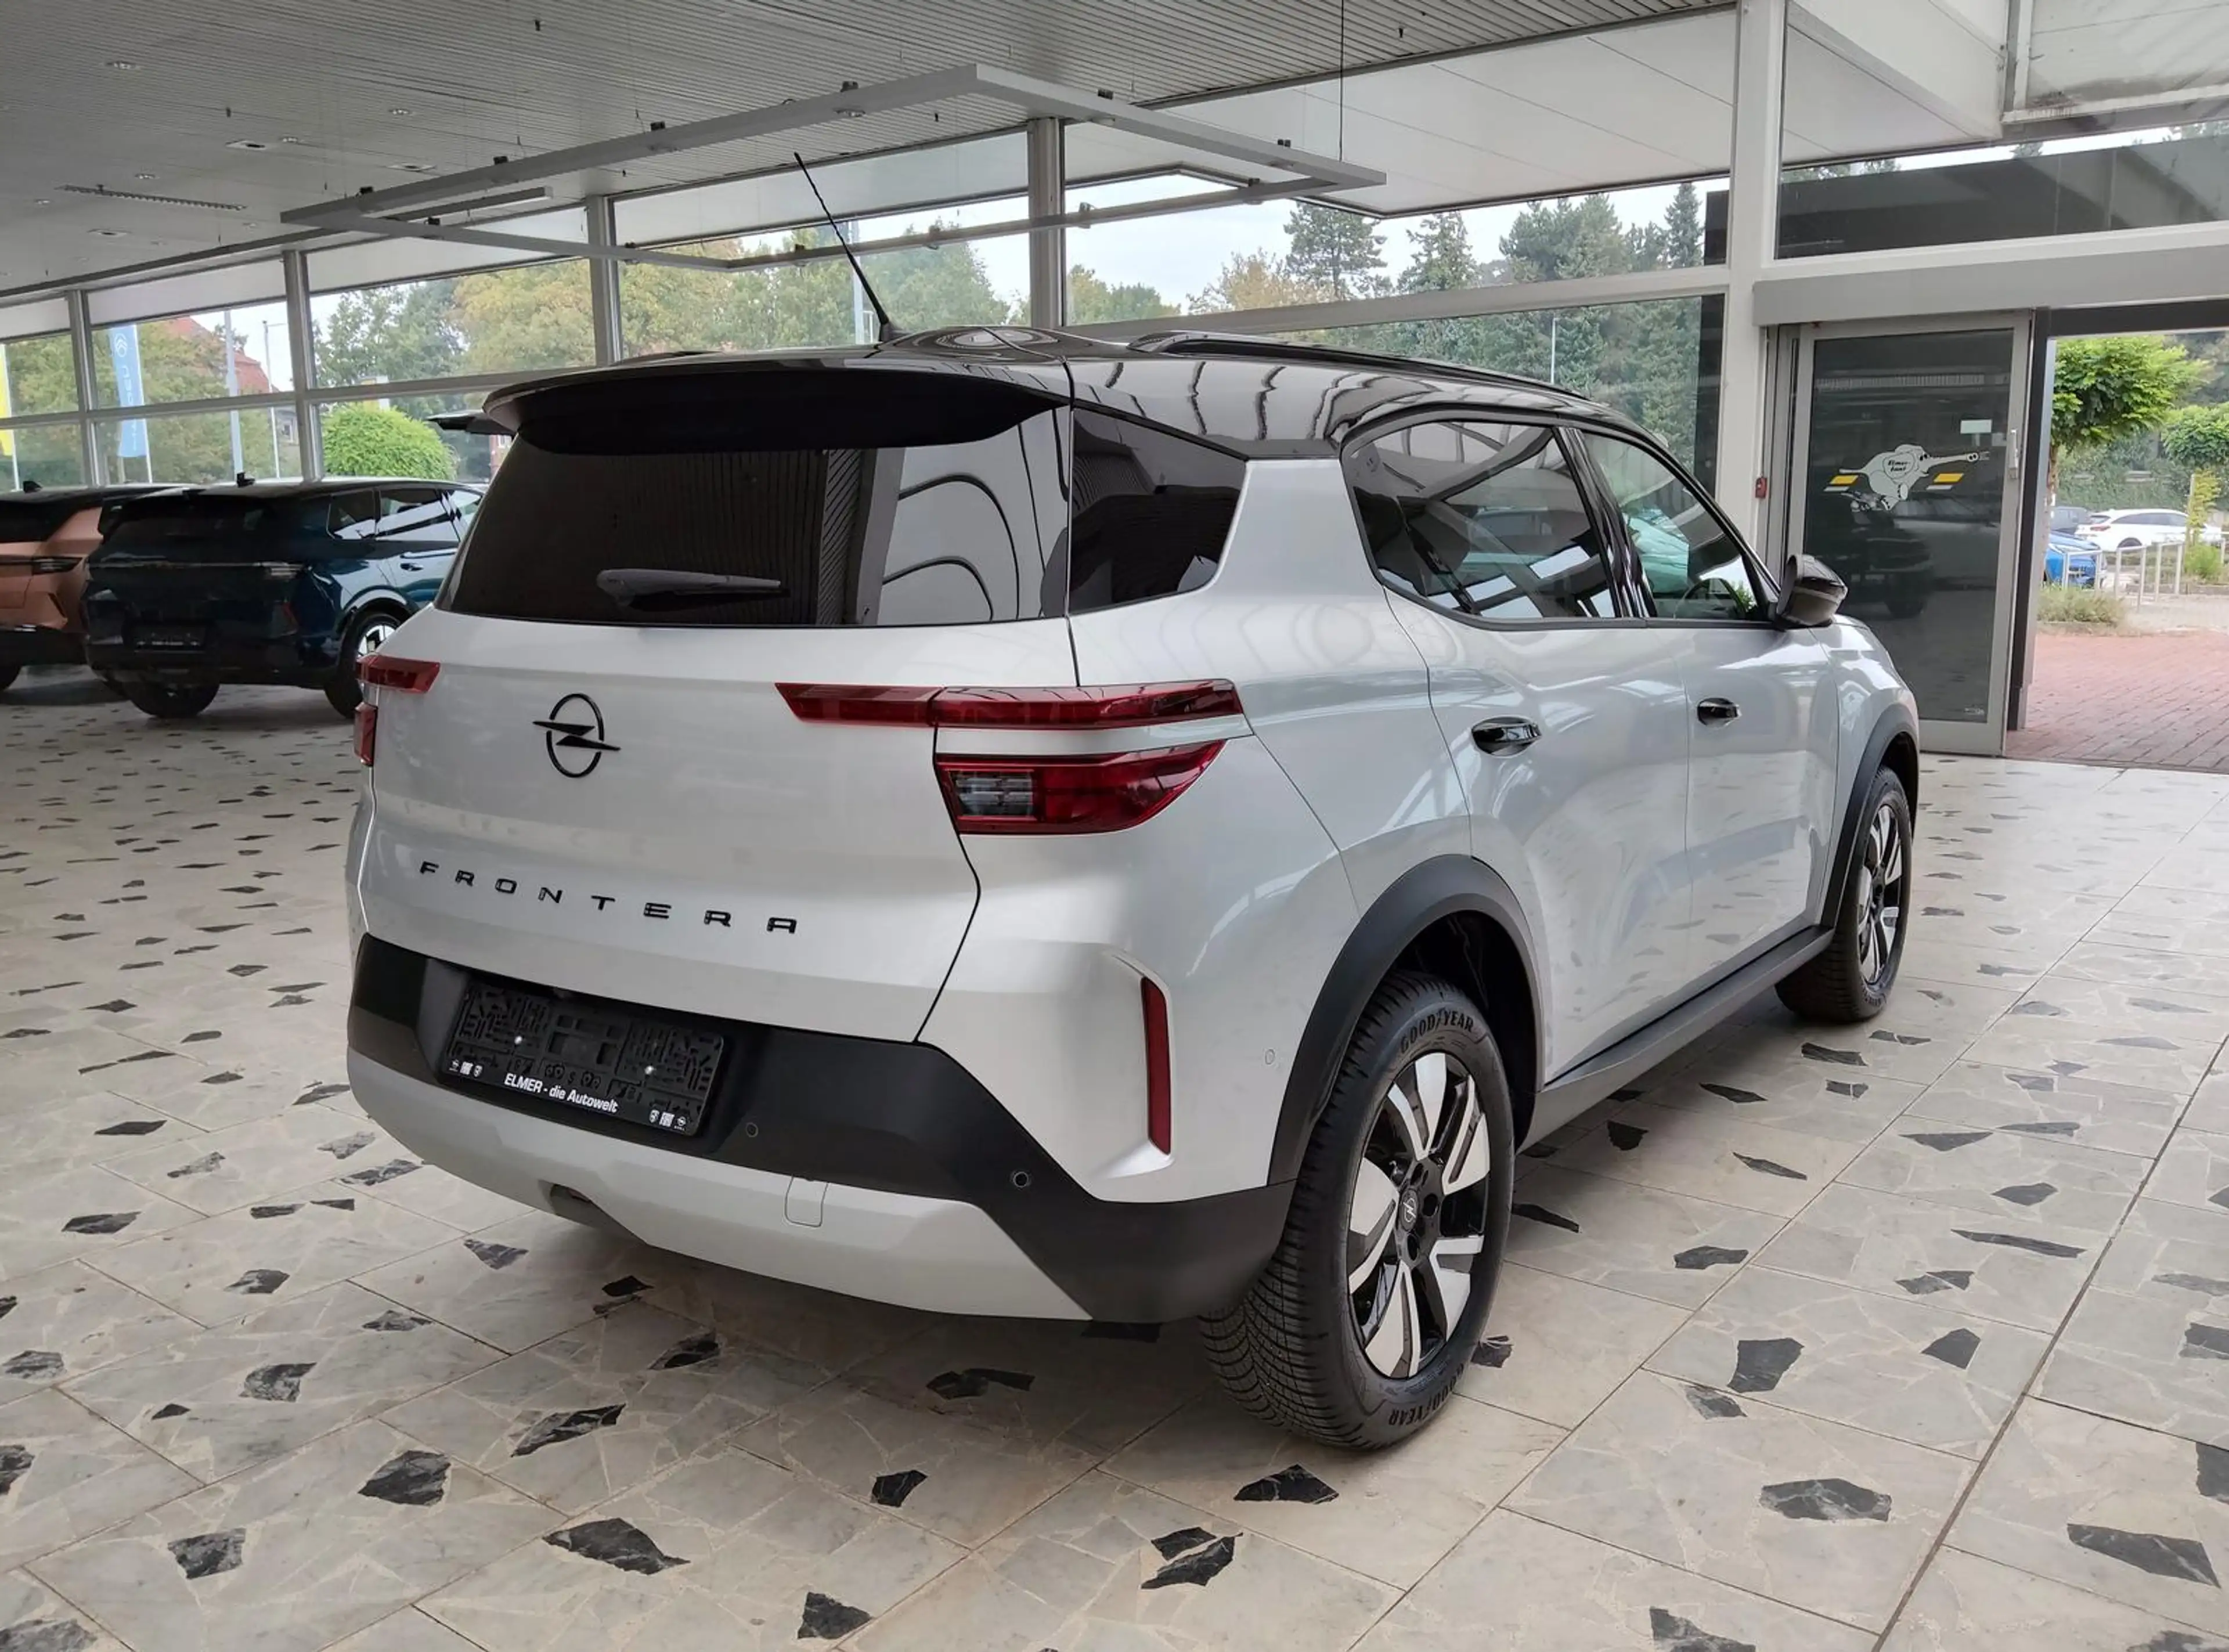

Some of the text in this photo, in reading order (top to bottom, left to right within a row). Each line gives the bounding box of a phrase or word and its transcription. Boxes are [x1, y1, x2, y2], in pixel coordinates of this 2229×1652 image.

[419, 861, 797, 934] FRONTERA
[1401, 1007, 1474, 1054] GOODYEAR
[504, 1073, 543, 1094] ELMER
[549, 1085, 566, 1099] die
[567, 1089, 619, 1113] Autowelt
